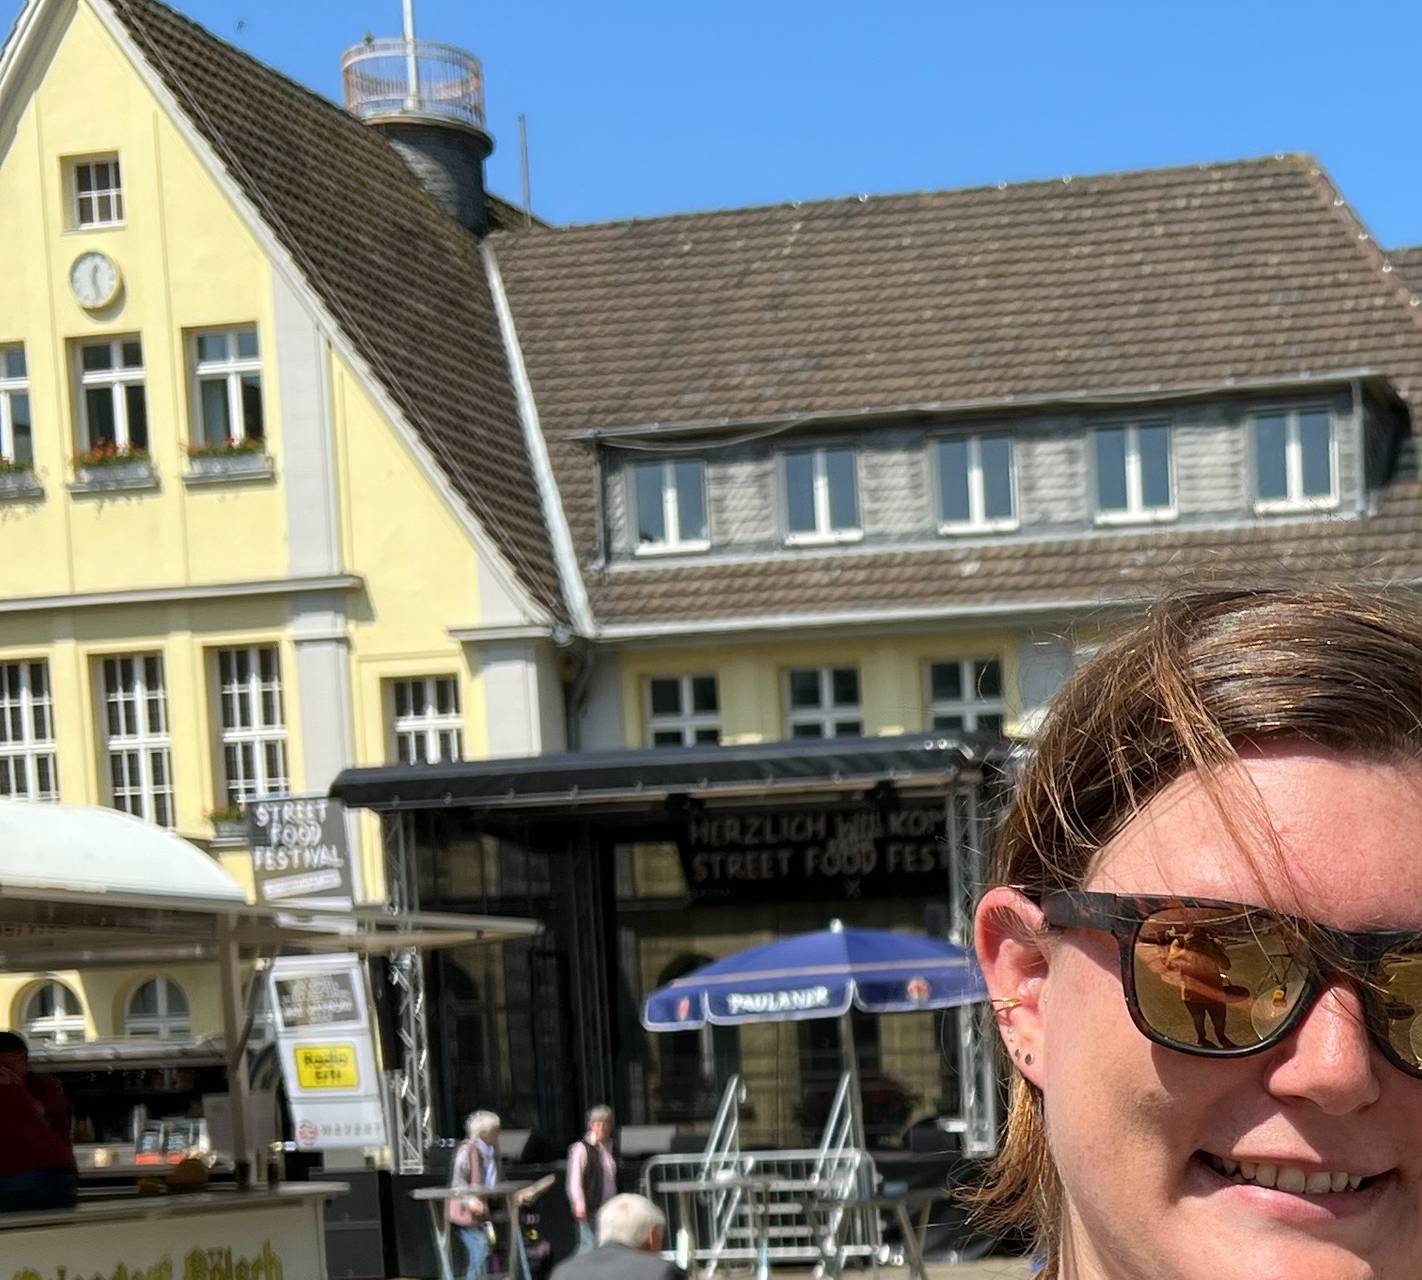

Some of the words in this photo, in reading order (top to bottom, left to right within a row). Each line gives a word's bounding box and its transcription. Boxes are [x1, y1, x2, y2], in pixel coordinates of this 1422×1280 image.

[255, 799, 328, 827] STREET
[270, 821, 322, 849] FOOD
[689, 810, 827, 847] HERZLICH
[254, 844, 344, 871] FESTIVAL
[691, 850, 792, 883] STREET
[804, 845, 878, 878] FOOD
[726, 985, 830, 1014] PAULANER
